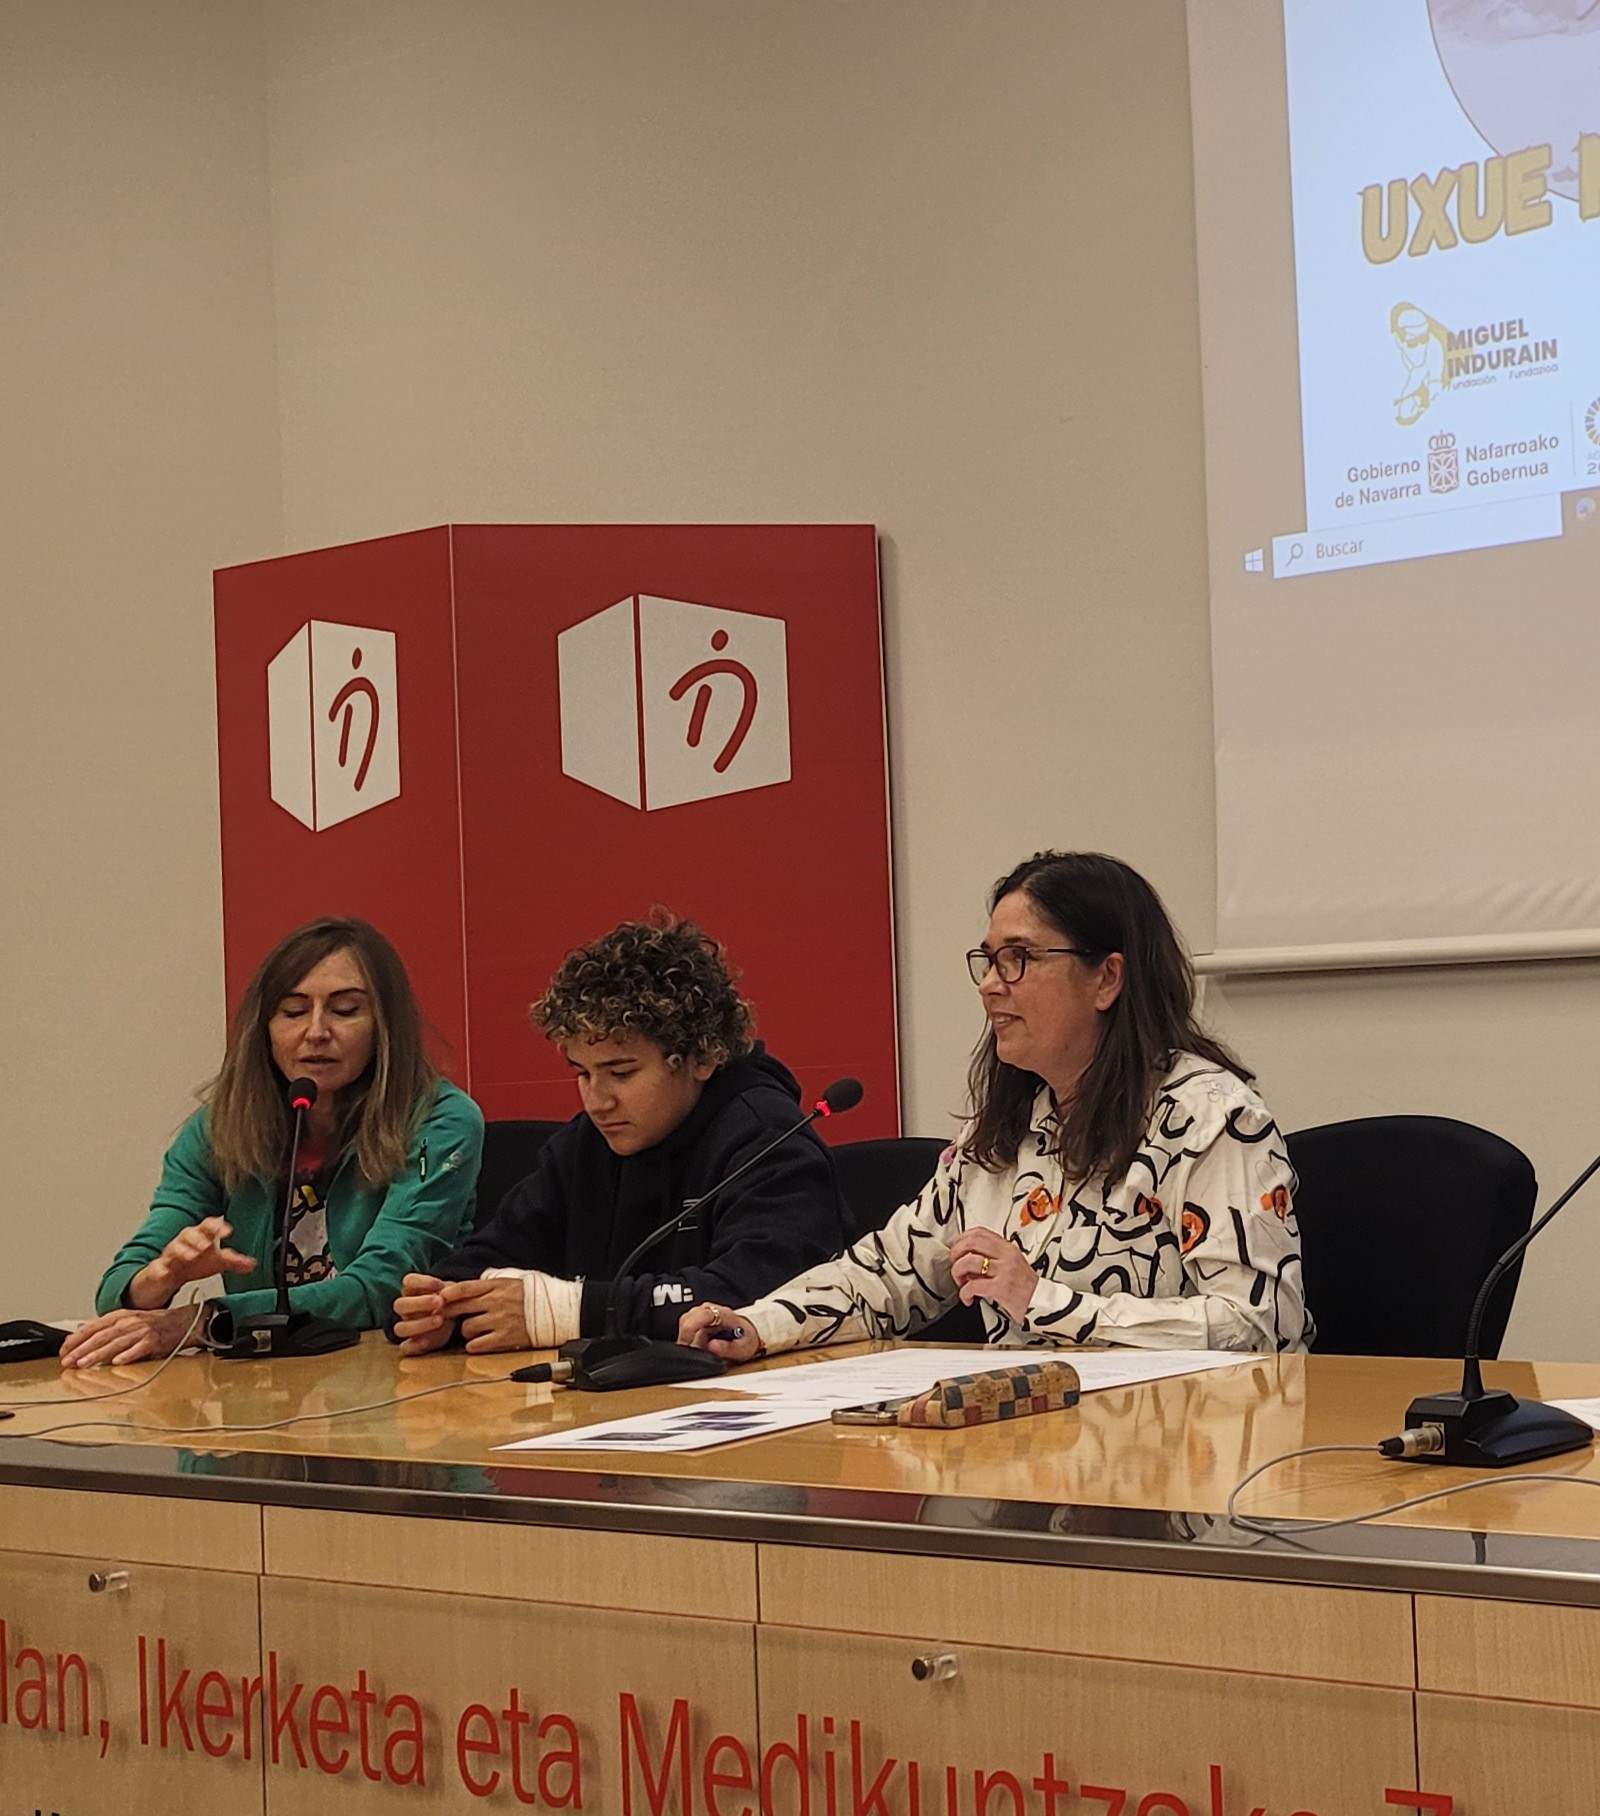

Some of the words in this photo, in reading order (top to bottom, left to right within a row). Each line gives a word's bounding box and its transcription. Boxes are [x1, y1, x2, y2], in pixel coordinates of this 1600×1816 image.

[1358, 143, 1553, 264] UXUE
[1446, 318, 1529, 352] MIGUEL
[1446, 338, 1558, 379] INDURAIN
[1466, 434, 1560, 463] Nafarroako
[1347, 459, 1421, 484] Gobierno
[1467, 460, 1549, 487] Gobernua
[1335, 492, 1354, 509] de
[1359, 483, 1422, 506] Navarra
[1315, 536, 1365, 561] Buscar
[137, 1635, 427, 1788] Ikerketa
[456, 1687, 584, 1811] eta
